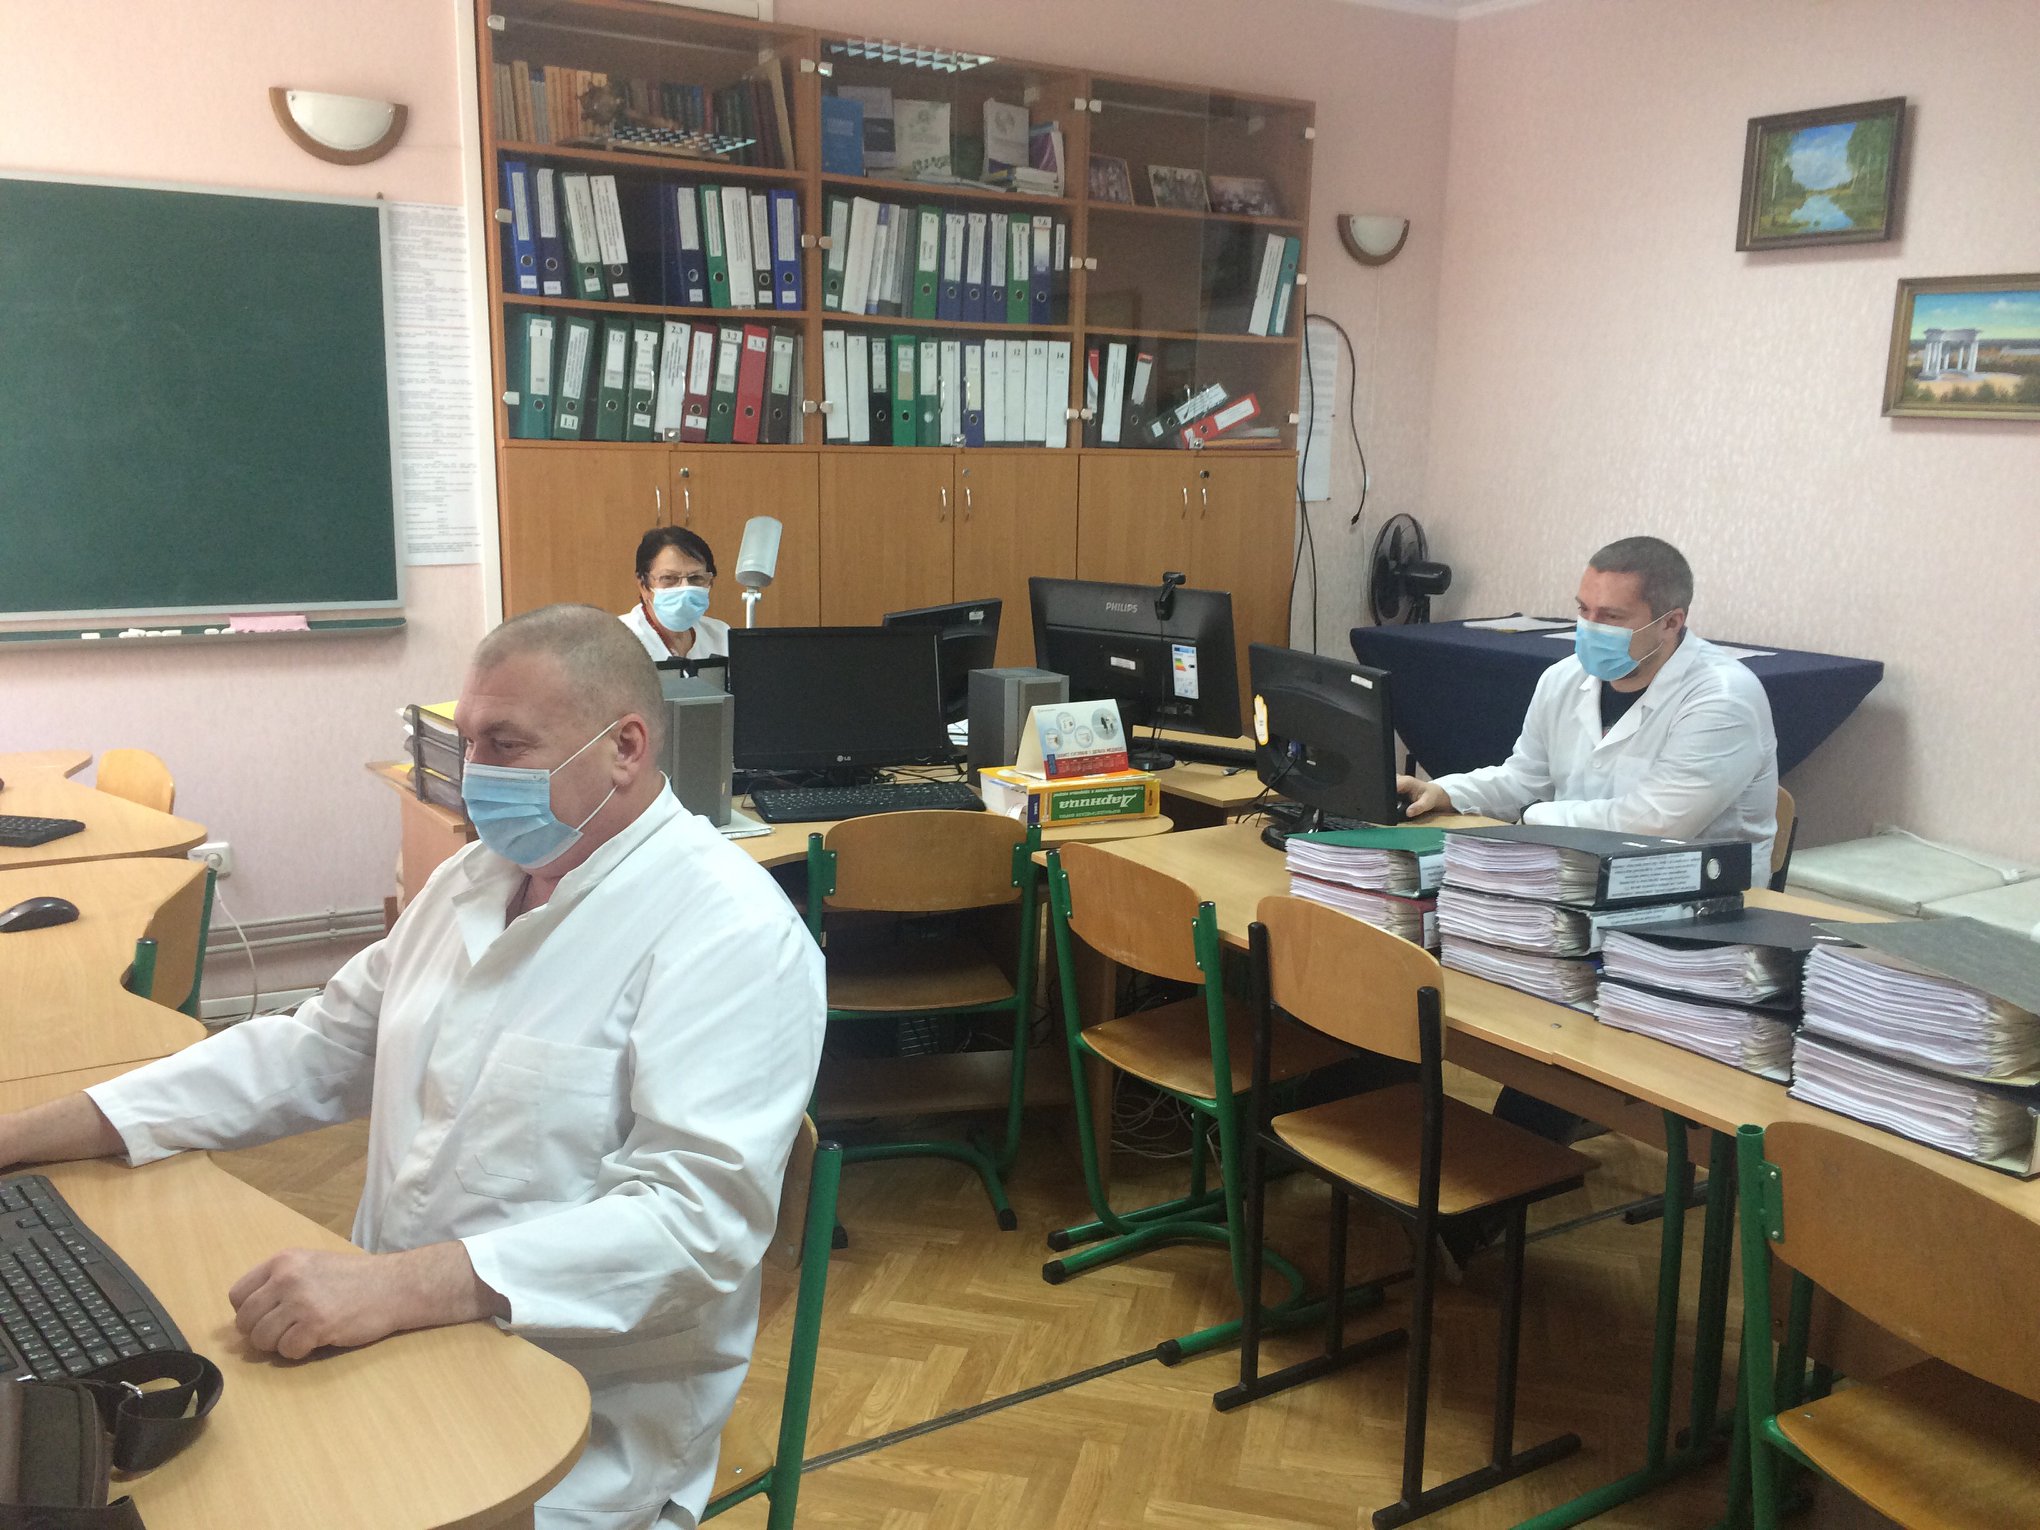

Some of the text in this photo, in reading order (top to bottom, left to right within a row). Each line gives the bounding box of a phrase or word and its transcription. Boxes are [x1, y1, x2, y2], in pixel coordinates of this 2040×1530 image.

[643, 333, 649, 341] 2
[1105, 601, 1138, 613] PHILIPS
[1058, 793, 1138, 810] Дарница
